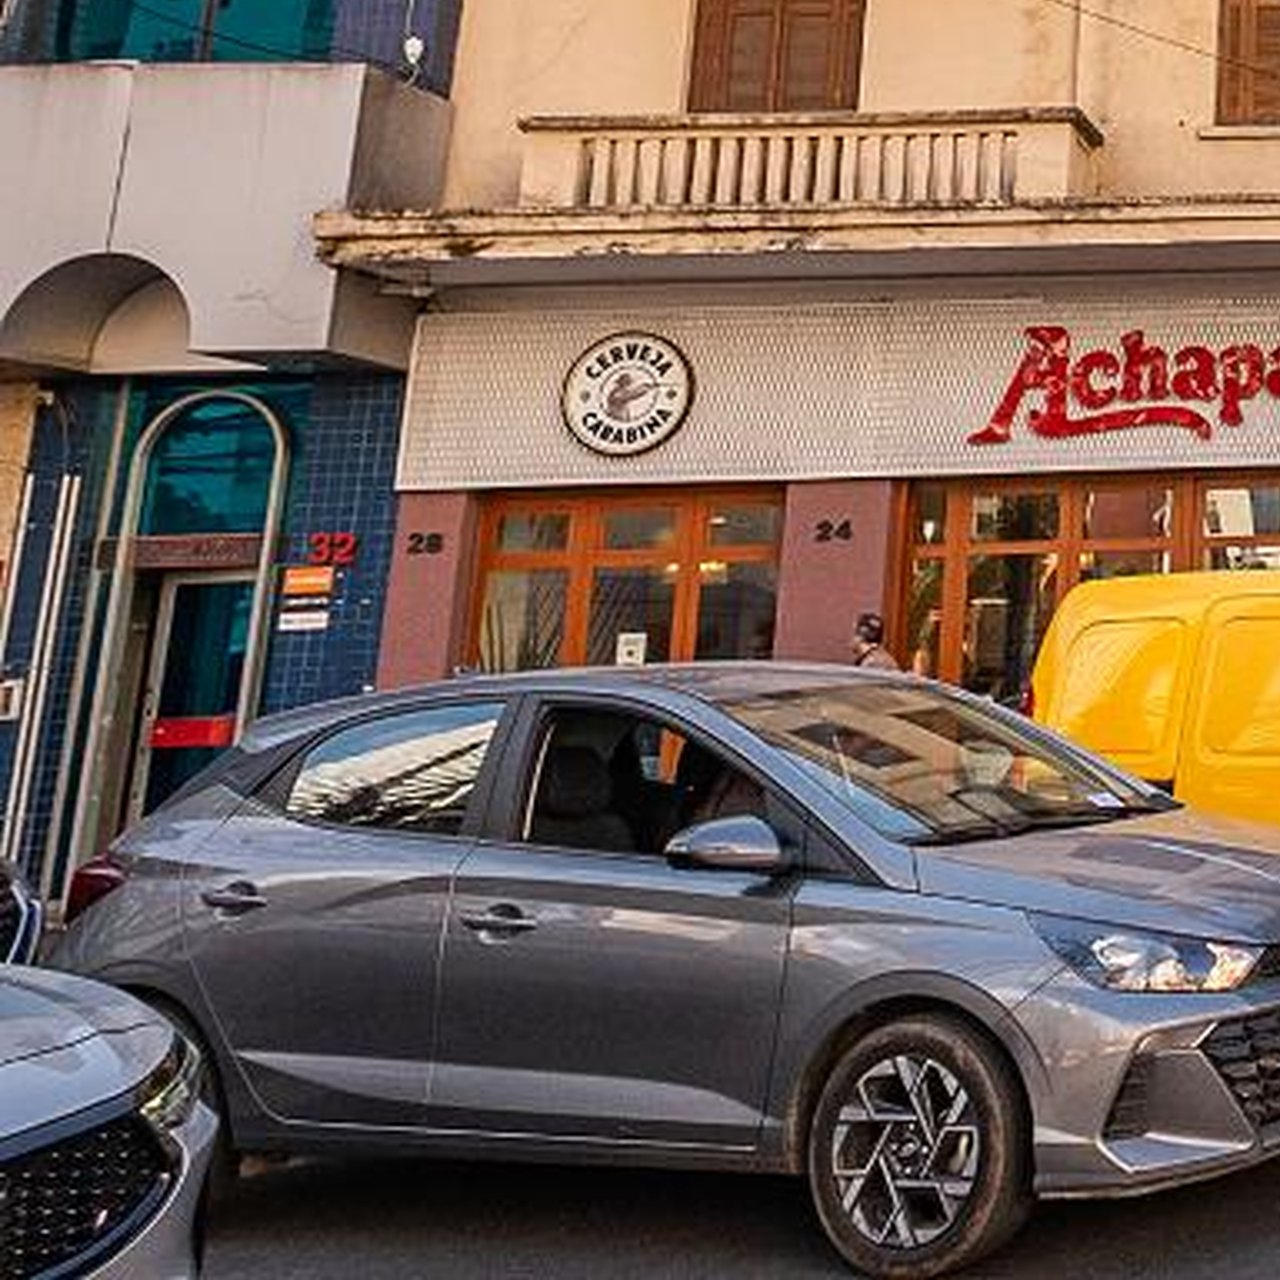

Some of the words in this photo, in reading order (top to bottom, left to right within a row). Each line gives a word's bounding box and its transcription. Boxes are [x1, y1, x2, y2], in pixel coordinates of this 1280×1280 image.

[586, 343, 673, 379] CERVEJA
[582, 409, 673, 444] CARABINA
[406, 532, 444, 555] 28
[815, 519, 854, 543] 24
[307, 532, 355, 564] 32
